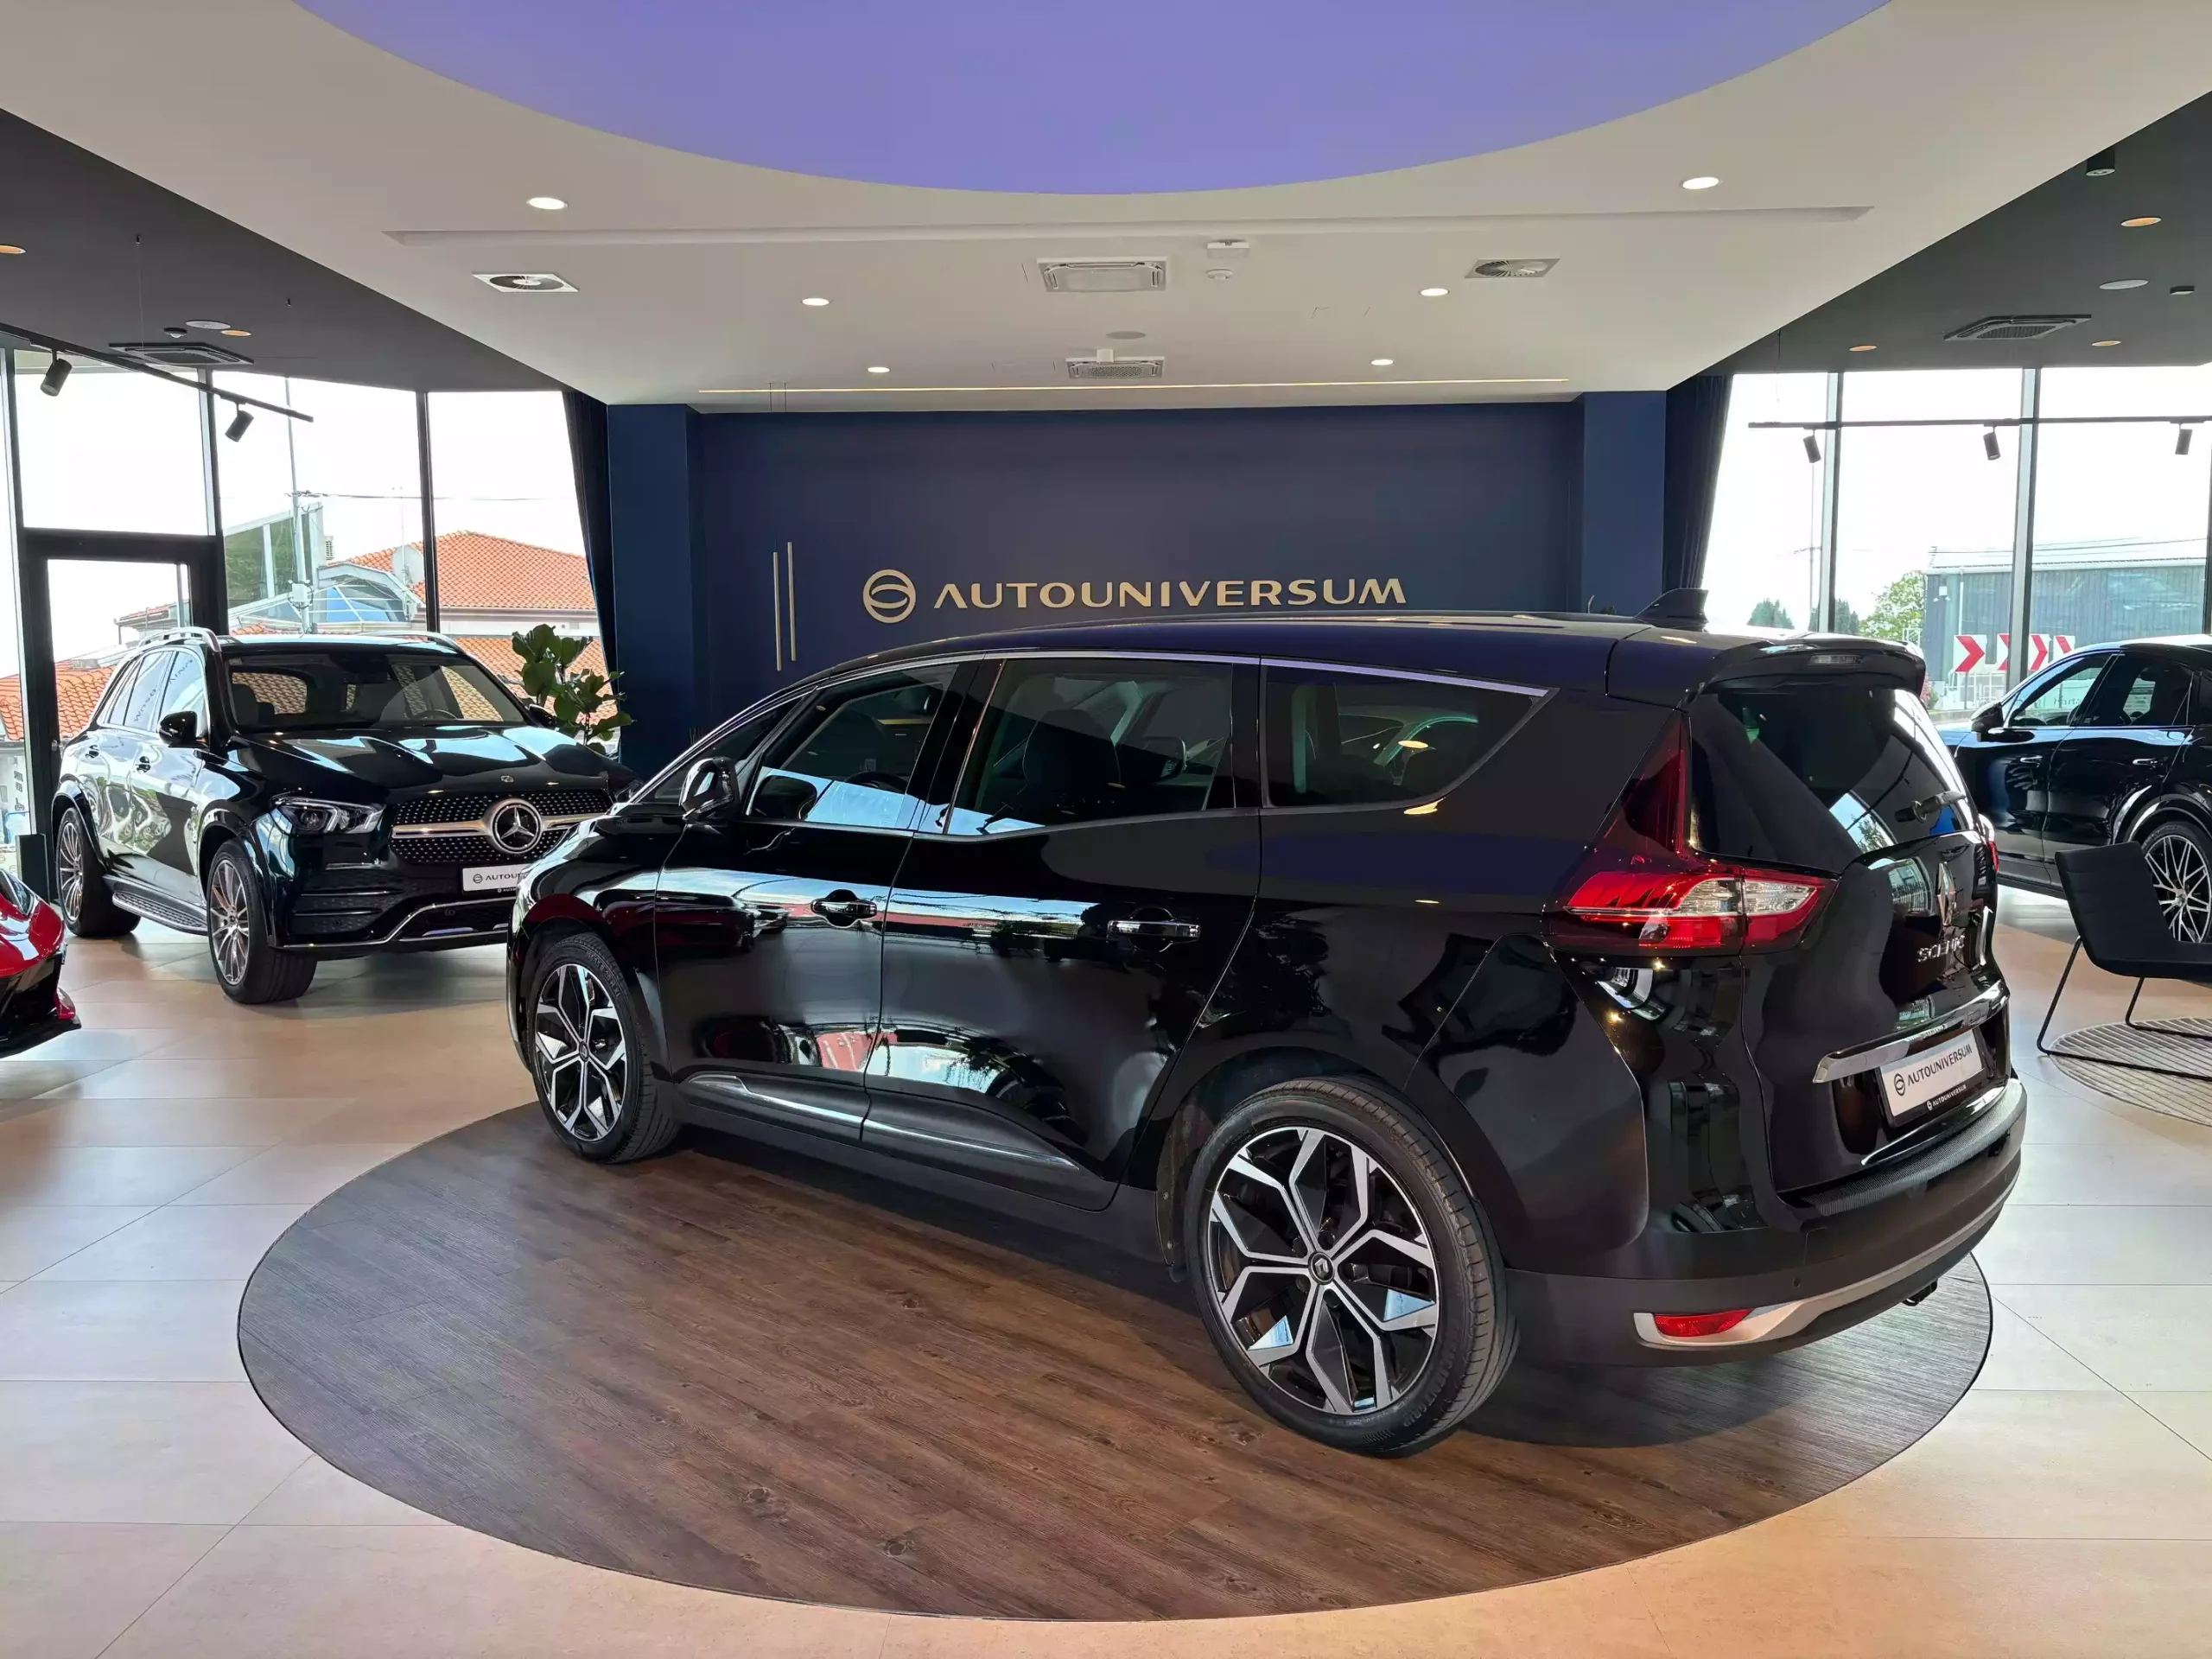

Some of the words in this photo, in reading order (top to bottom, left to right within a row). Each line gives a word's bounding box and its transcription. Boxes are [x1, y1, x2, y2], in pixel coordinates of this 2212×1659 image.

[934, 578, 1407, 609] AUTOUNIVERSUM
[1908, 1044, 1973, 1086] AUTOUNIVERSUM
[1932, 1084, 1967, 1107] AUTOUNIVERSUM
